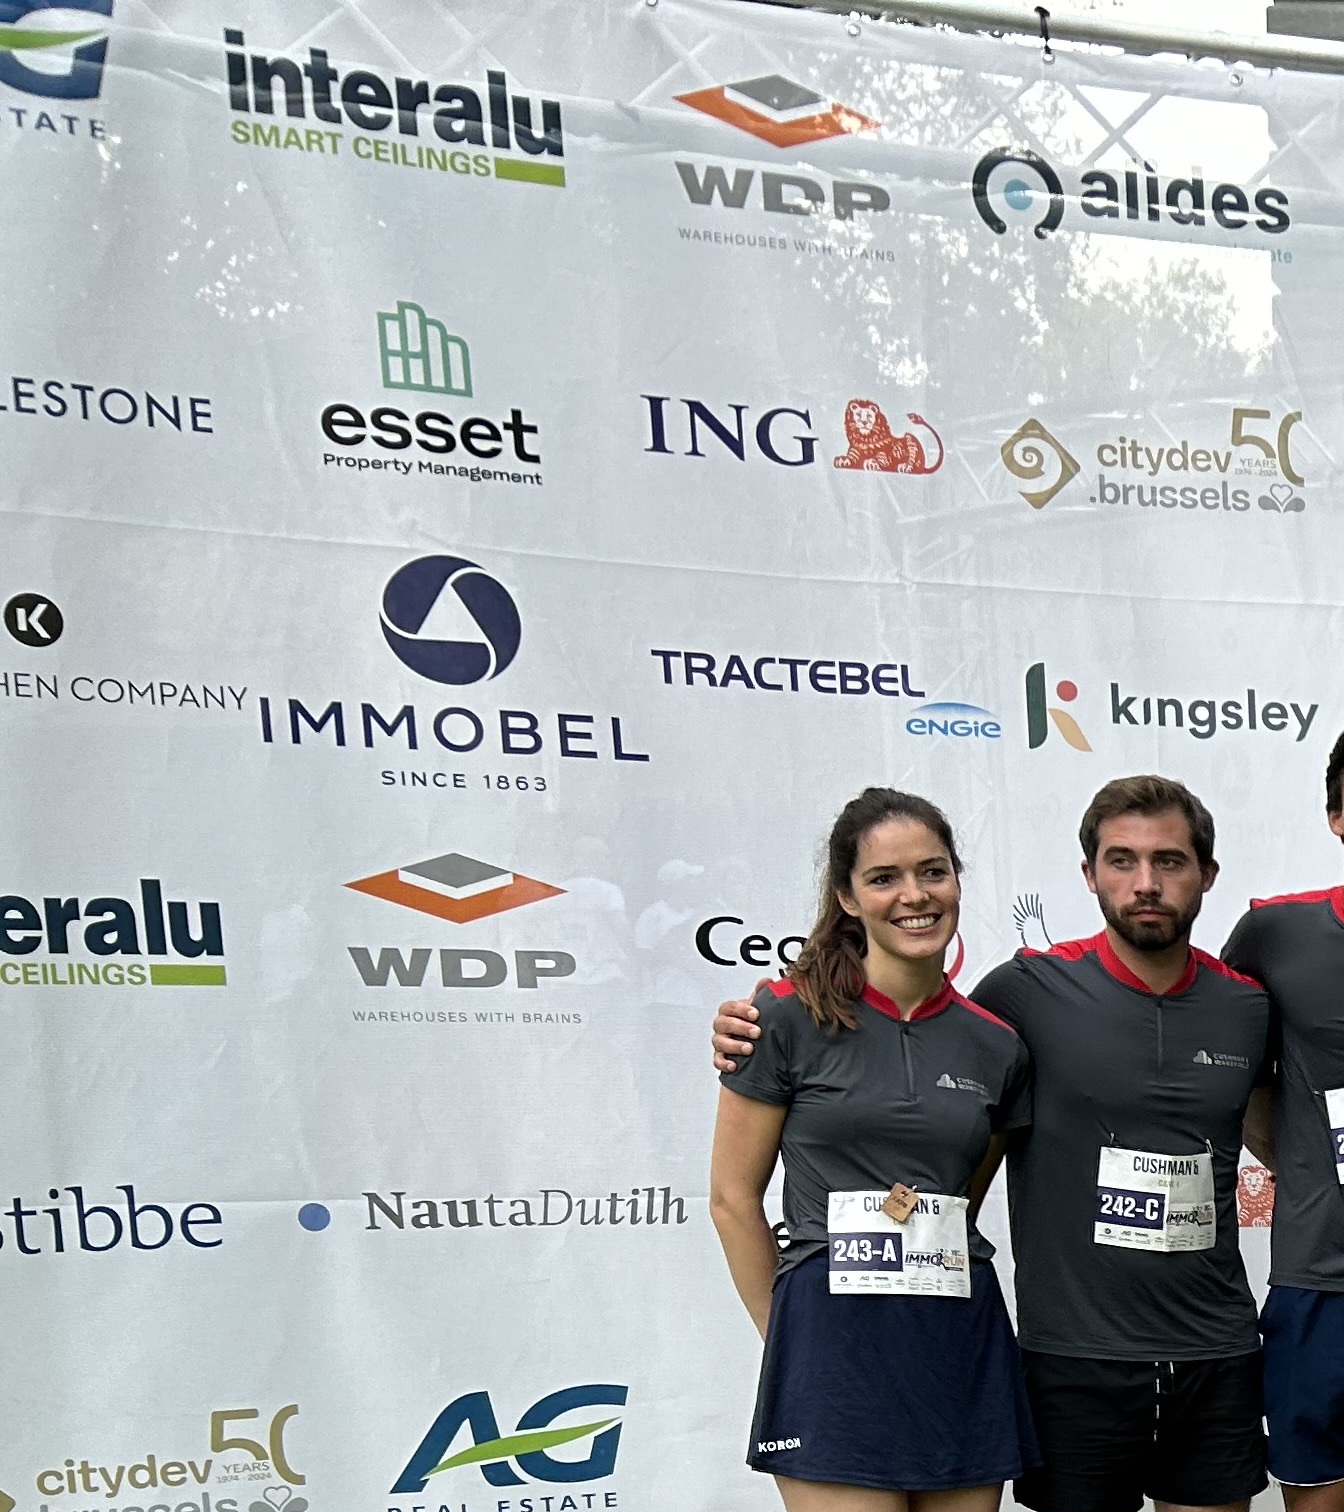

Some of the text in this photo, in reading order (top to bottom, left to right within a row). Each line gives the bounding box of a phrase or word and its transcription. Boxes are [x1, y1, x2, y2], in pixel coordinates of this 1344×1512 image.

[223, 27, 565, 157] interalu
[231, 120, 492, 179] SMART CEILINGS
[675, 161, 891, 221] WDP
[1081, 158, 1290, 233] alides
[678, 227, 787, 249] WAREHOUSES
[0, 377, 214, 434] ESTONE
[320, 402, 541, 464] esset
[641, 393, 820, 468] ING
[323, 451, 543, 486] Property Management
[1097, 436, 1232, 477] citydev
[1089, 474, 1251, 512] .brussels
[71, 676, 249, 711] COMPANY
[651, 649, 925, 698] TRACTEBEL
[259, 697, 650, 762] IMMOBEL
[1111, 683, 1319, 742] kingsley
[381, 770, 548, 793] SINCE 1863
[0, 962, 147, 986] CEILINGS
[348, 946, 577, 988] WDP
[352, 1010, 583, 1025] WAREHOUSES WITH BRAINS
[1133, 1156, 1193, 1176] CUSHMAN
[0, 1184, 224, 1255] tibbe
[362, 1186, 688, 1230] NautaDutilh
[1100, 1194, 1159, 1221] 242-C
[834, 1239, 897, 1262] 243-A
[388, 1383, 629, 1496] AG
[35, 1453, 213, 1499] citydev
[222, 1460, 271, 1476] YEARS
